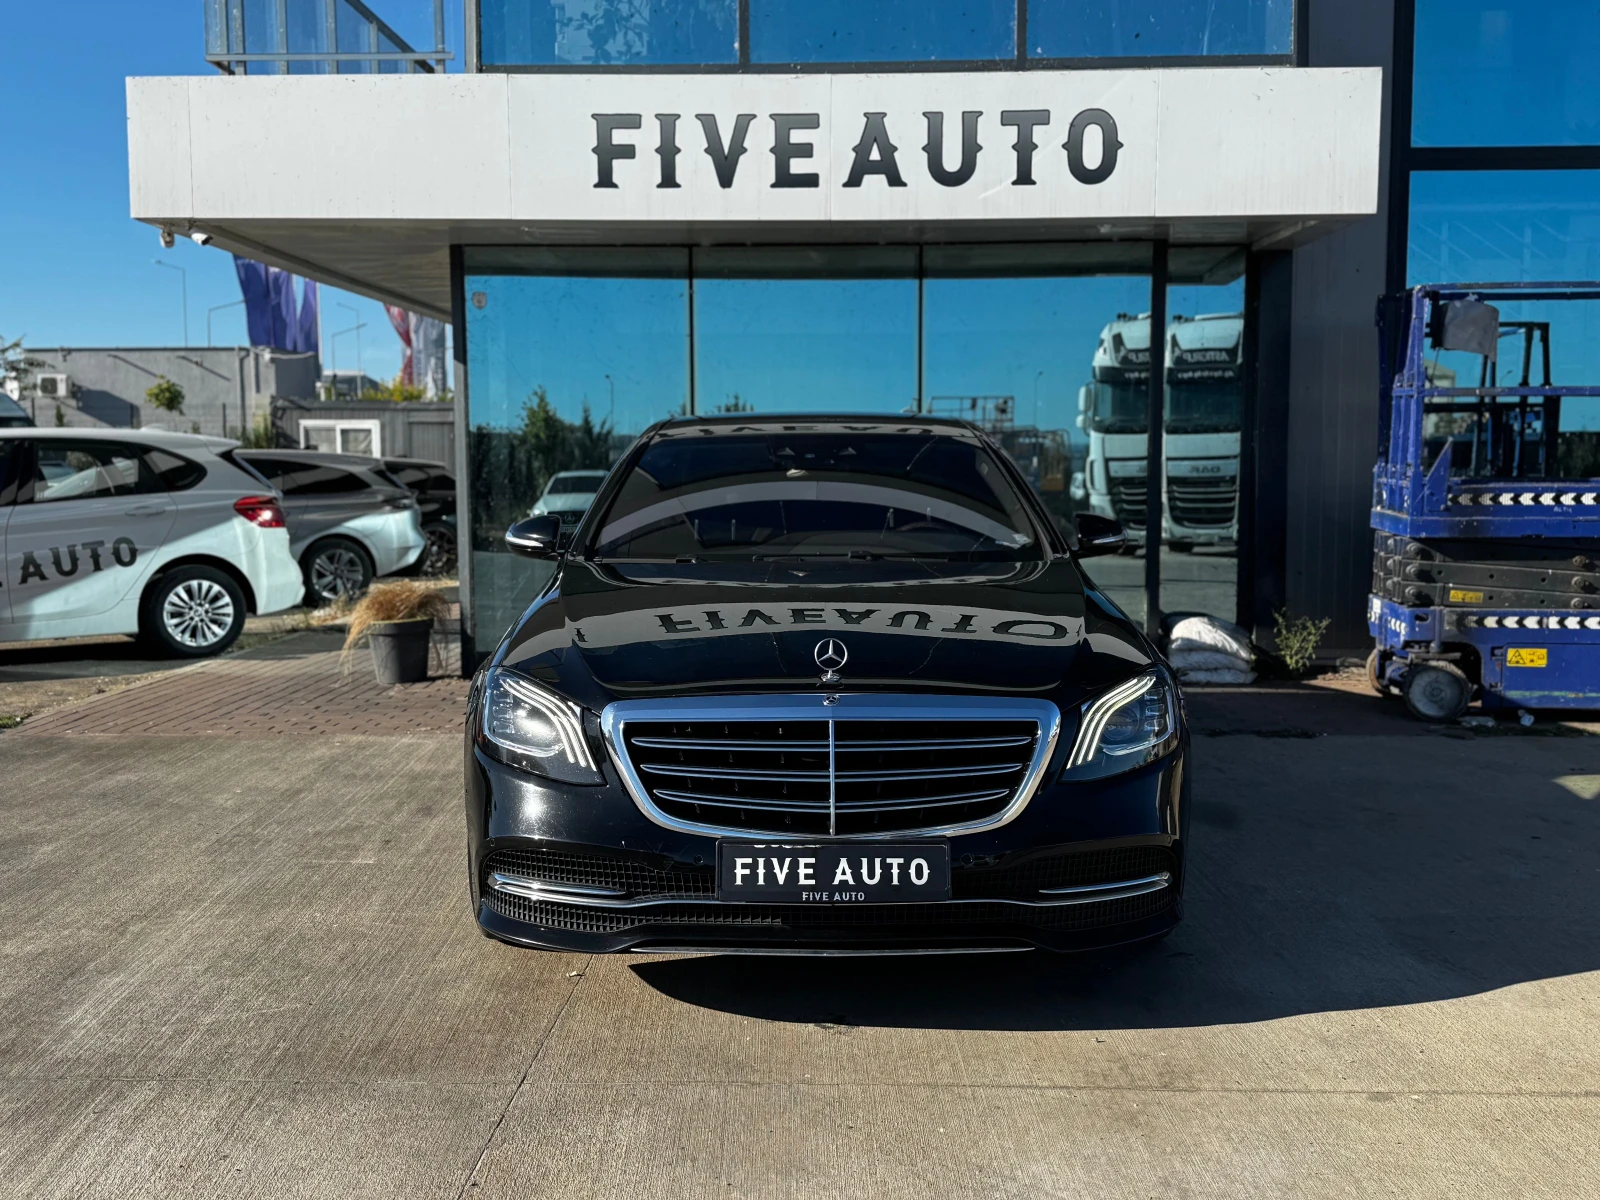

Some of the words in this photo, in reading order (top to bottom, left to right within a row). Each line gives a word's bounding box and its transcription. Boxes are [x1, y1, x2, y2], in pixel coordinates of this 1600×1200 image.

[18, 536, 139, 585] AUTO
[735, 857, 816, 885] FIVE
[832, 857, 930, 885] AUTO
[802, 891, 829, 901] FIVE
[834, 891, 865, 901] AUTO
